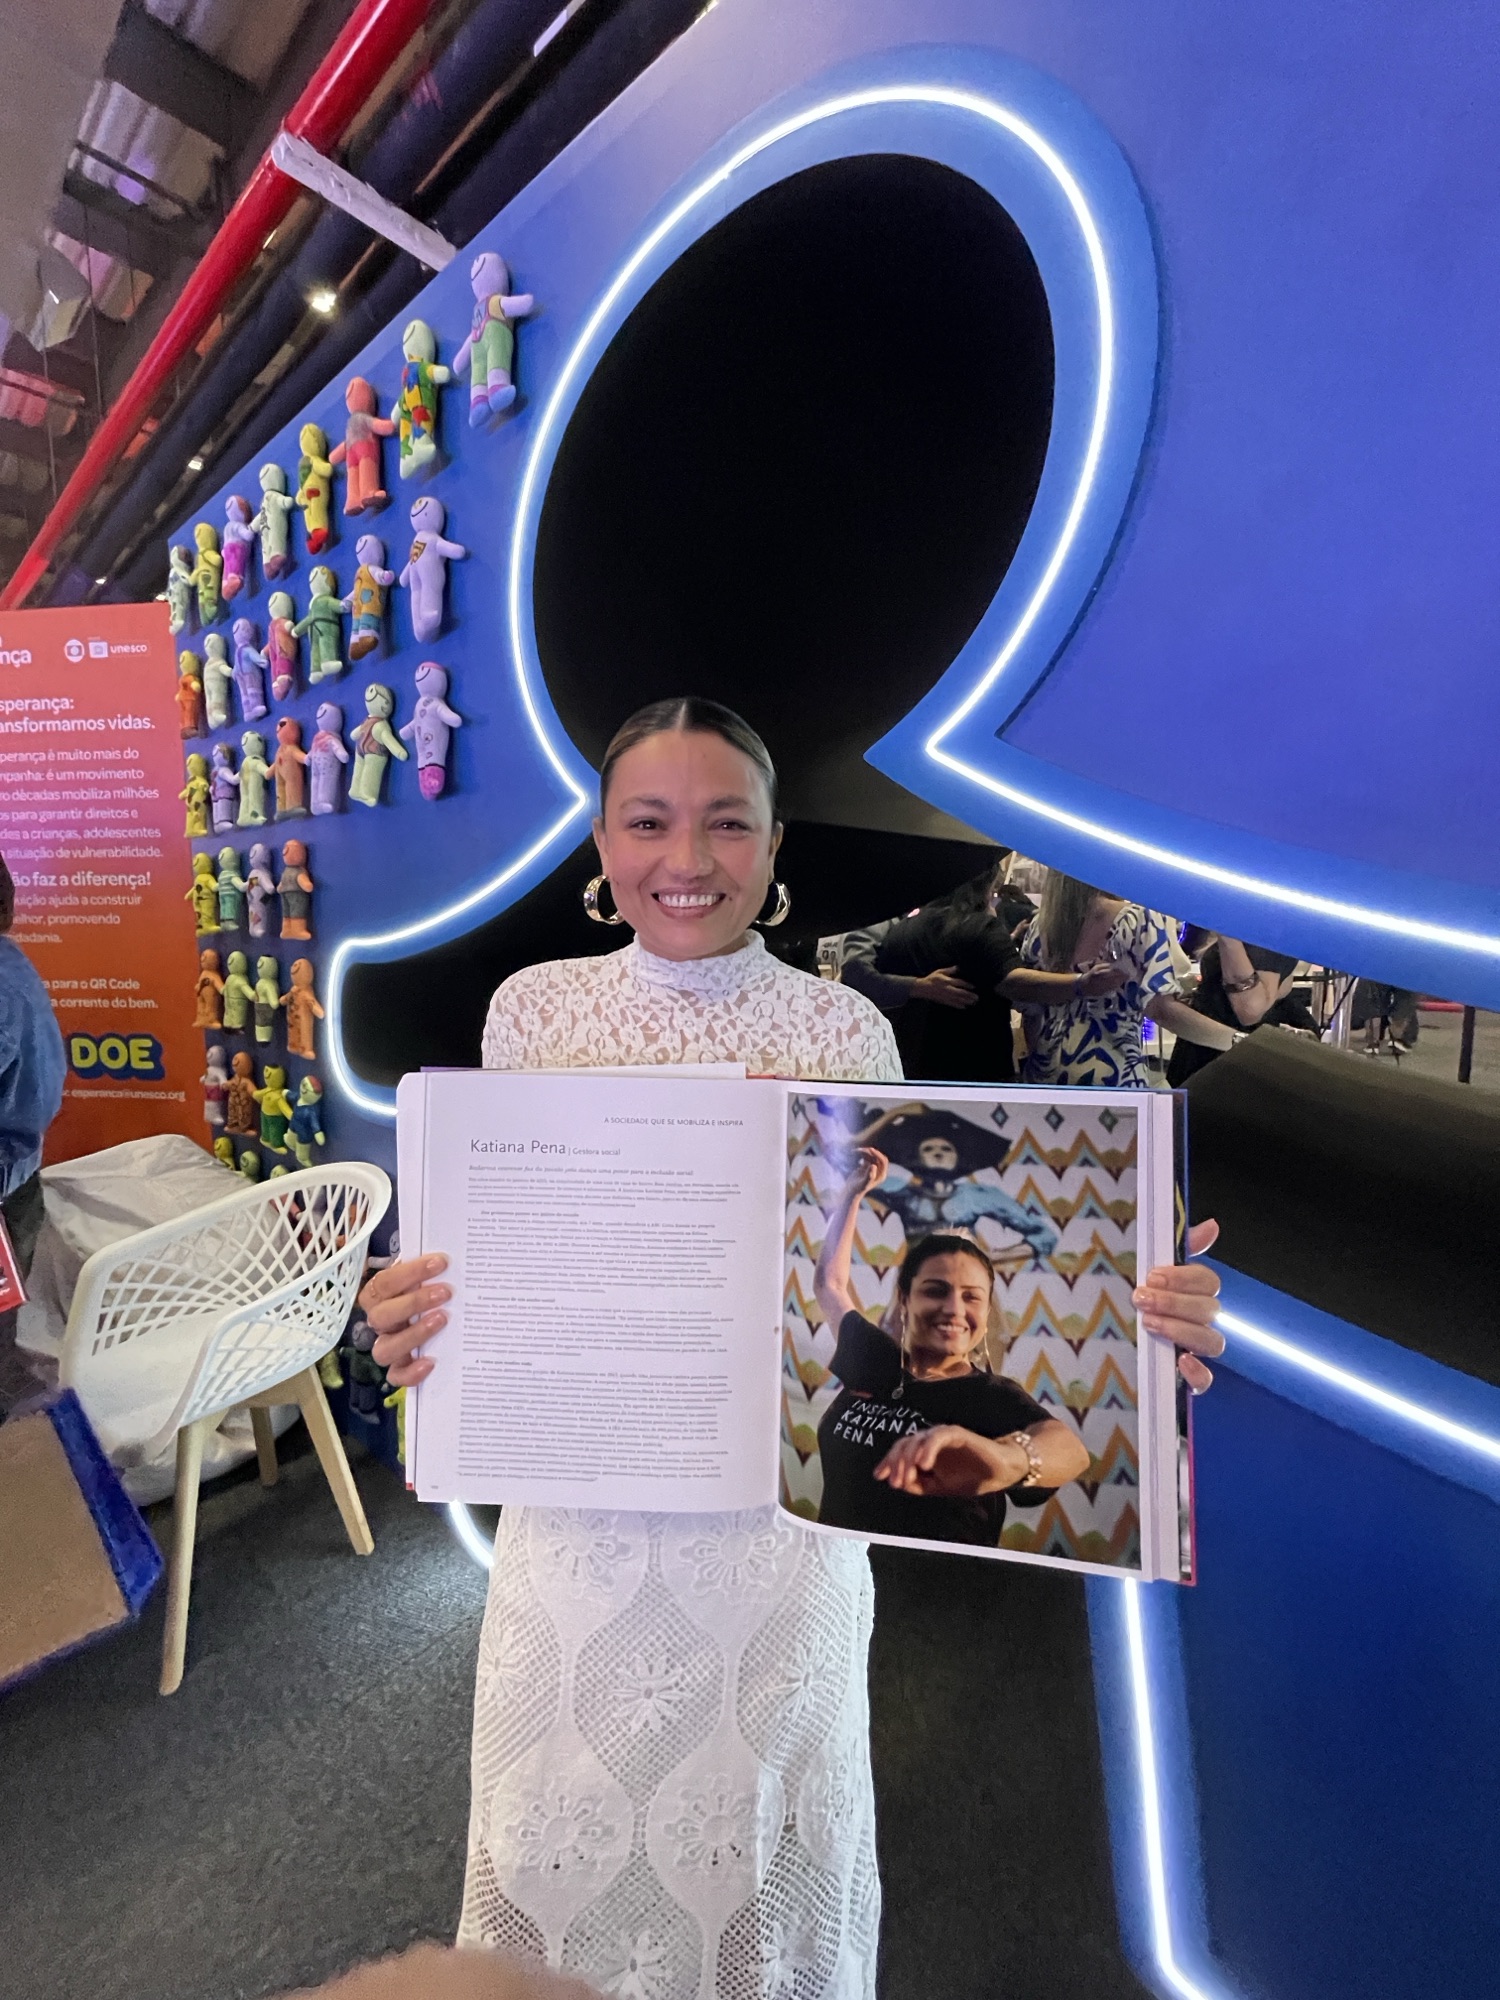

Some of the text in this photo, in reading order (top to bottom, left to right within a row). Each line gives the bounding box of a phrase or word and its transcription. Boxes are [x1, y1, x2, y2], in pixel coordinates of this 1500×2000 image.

[110, 644, 148, 654] unesco
[107, 713, 156, 731] vidas.
[48, 749, 55, 761] é
[57, 749, 92, 761] muito
[93, 748, 121, 760] mais
[123, 747, 140, 760] do
[46, 769, 54, 780] é
[56, 771, 75, 781] um
[76, 767, 145, 780] movimento
[12, 788, 60, 801] décadas
[62, 788, 111, 800] mobiliza
[113, 786, 160, 799] milhões
[12, 811, 38, 822] para
[39, 808, 82, 823] garantir
[85, 807, 129, 819] direitos
[131, 809, 139, 819] e
[22, 830, 30, 840] a
[31, 829, 82, 842] crianças,
[83, 827, 161, 839] adolescentes
[7, 847, 55, 861] situação
[56, 847, 71, 859] de
[72, 845, 164, 859] vulnerabilidade.
[33, 872, 57, 887] faz
[60, 874, 69, 886] a
[71, 870, 151, 890] diferença!
[49, 894, 80, 908] ajuda
[81, 896, 89, 906] a
[90, 893, 142, 906] construir
[48, 913, 121, 926] promovendo
[52, 980, 78, 991] para
[80, 981, 88, 989] o
[90, 978, 107, 989] QR
[108, 978, 141, 990] Code
[59, 998, 109, 1008] corrente
[111, 997, 127, 1008] do
[128, 997, 158, 1009] bem.
[70, 1037, 155, 1070] DOE
[611, 1117, 649, 1125] SOCIEDADE
[651, 1118, 666, 1126] QUE
[677, 1118, 710, 1126] MOBILIZA
[470, 1139, 525, 1153] Katiana
[531, 1140, 566, 1154] Pena
[572, 1147, 600, 1156] Gestora
[601, 1147, 621, 1156] social
[841, 1410, 918, 1436] KATIANA
[833, 1422, 874, 1447] PENA
